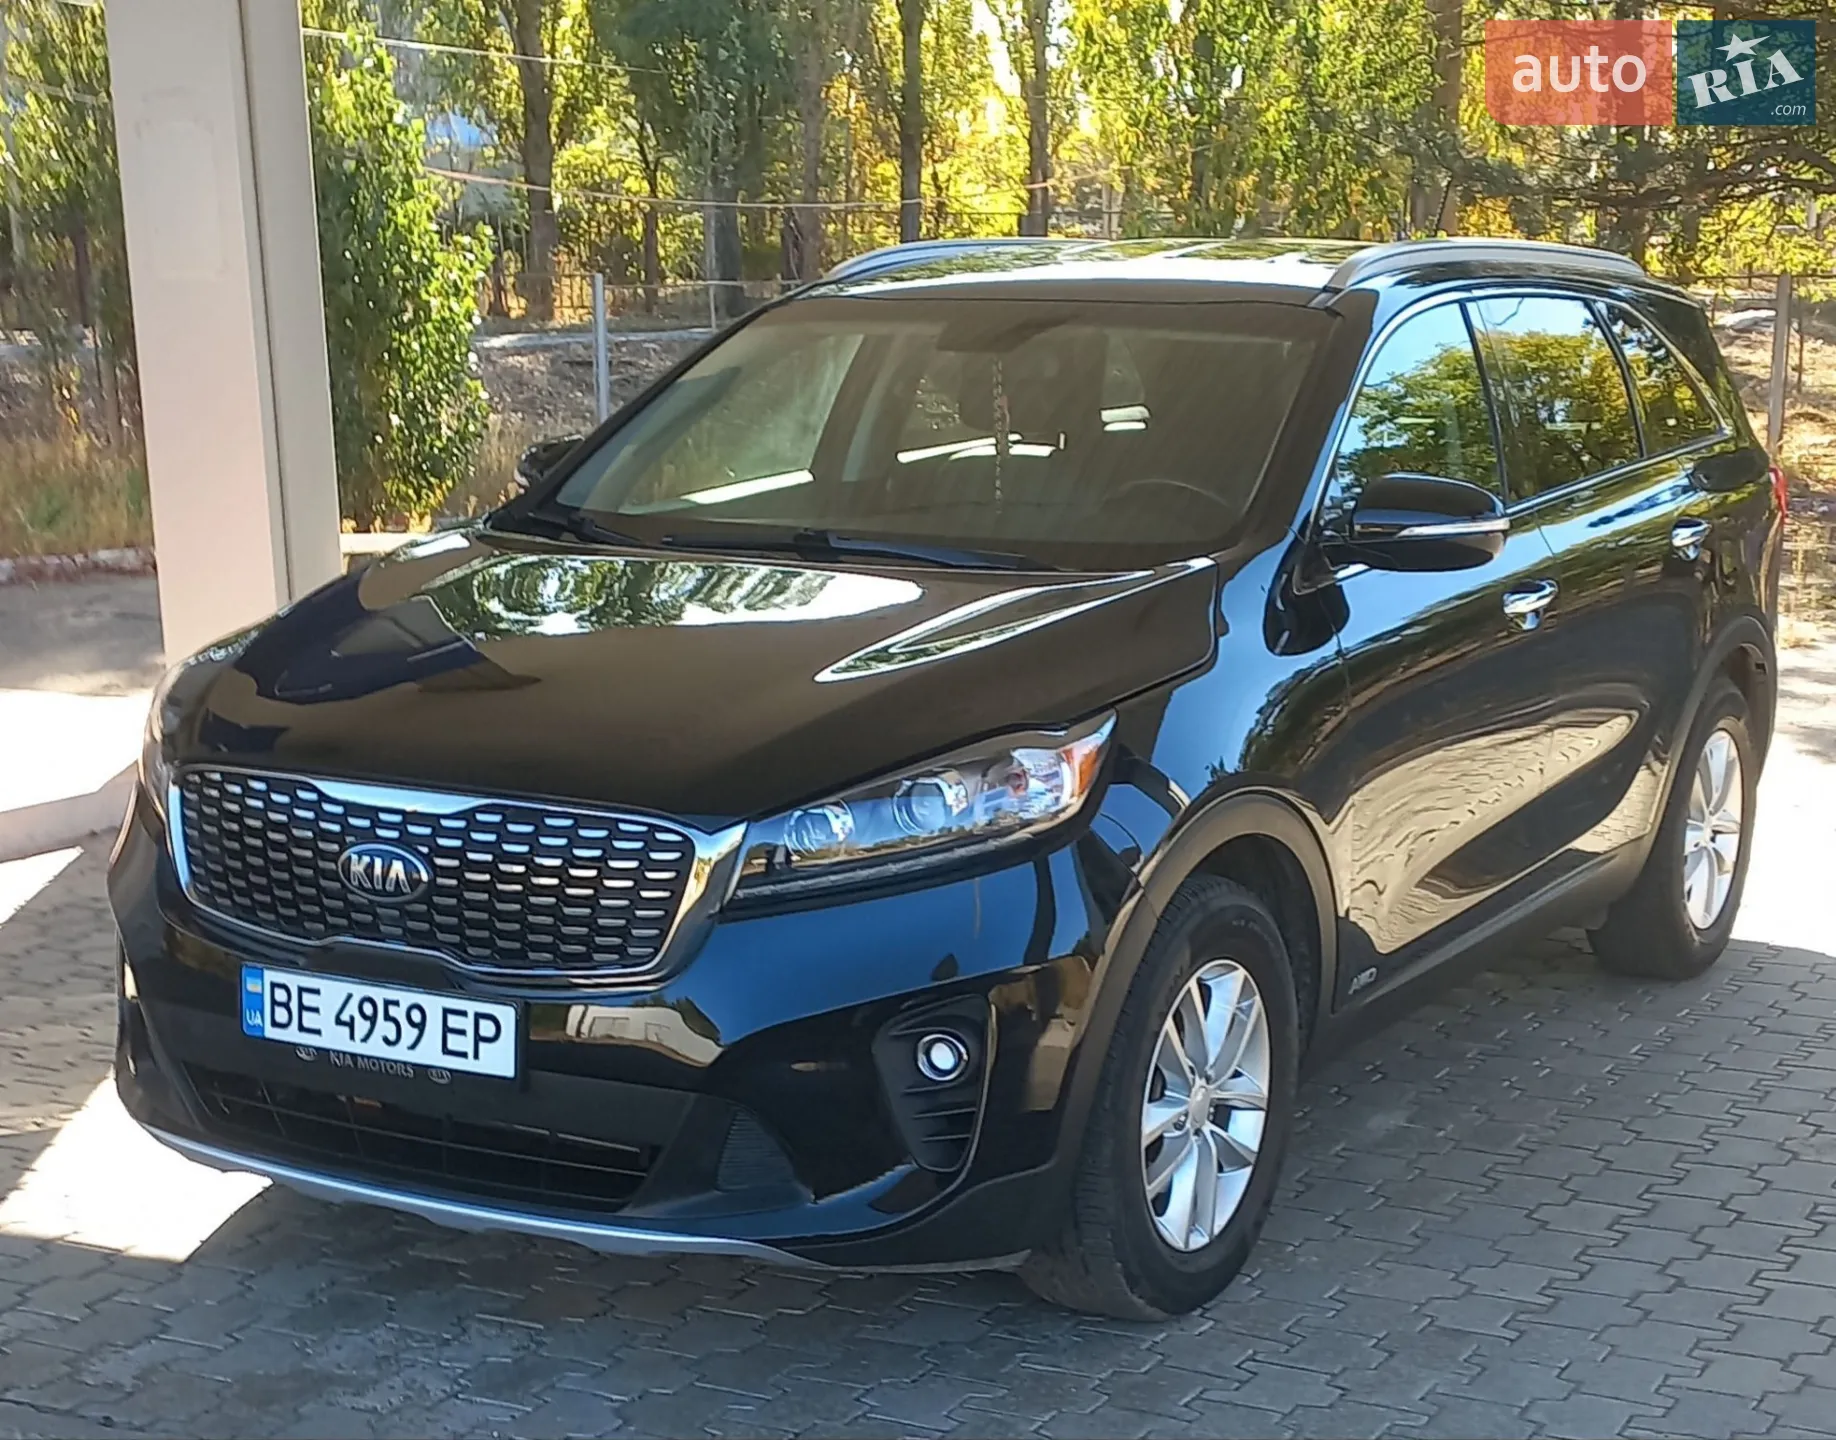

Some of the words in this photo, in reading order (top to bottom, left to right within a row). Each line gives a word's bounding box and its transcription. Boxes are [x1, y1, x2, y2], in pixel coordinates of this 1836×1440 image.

[350, 853, 411, 893] KIA
[246, 1008, 264, 1027] UA
[269, 981, 322, 1036] BE
[334, 992, 427, 1050] 4959
[441, 1007, 502, 1060] EP
[357, 1056, 415, 1079] MOTORS
